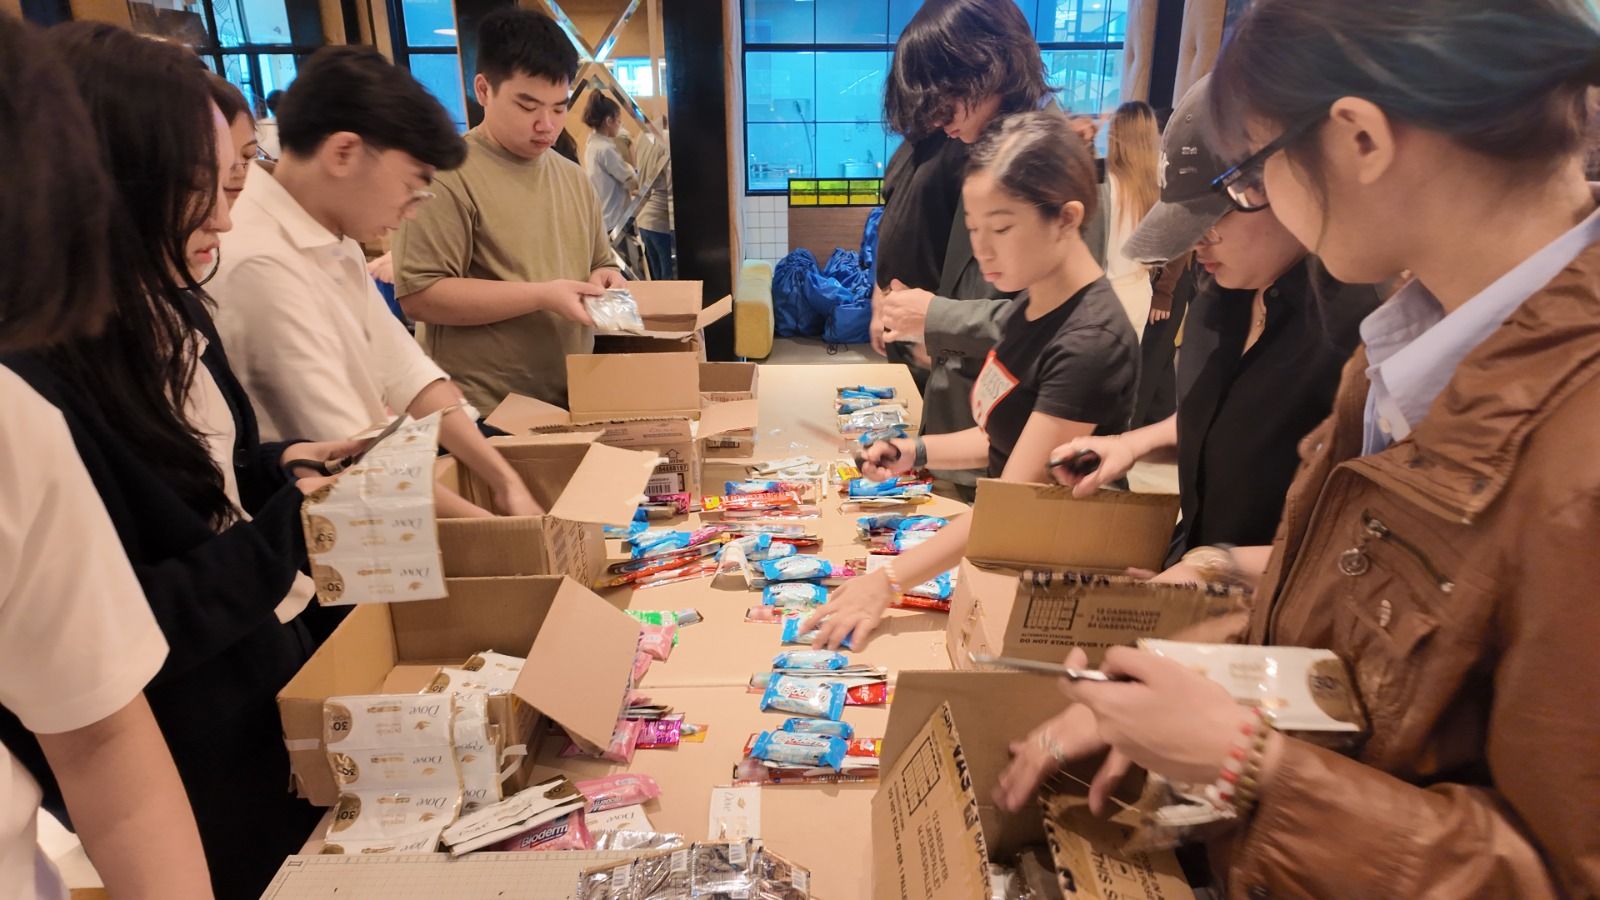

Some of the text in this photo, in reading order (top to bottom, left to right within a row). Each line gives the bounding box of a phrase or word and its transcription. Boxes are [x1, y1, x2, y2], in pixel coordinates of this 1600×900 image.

[407, 703, 441, 717] Dove
[333, 721, 349, 731] 30
[412, 754, 443, 765] Dove
[463, 788, 487, 800] Dov
[416, 796, 449, 810] Dove
[520, 825, 569, 849] Bioderm
[892, 818, 900, 843] STACK
[399, 837, 430, 852] Dove
